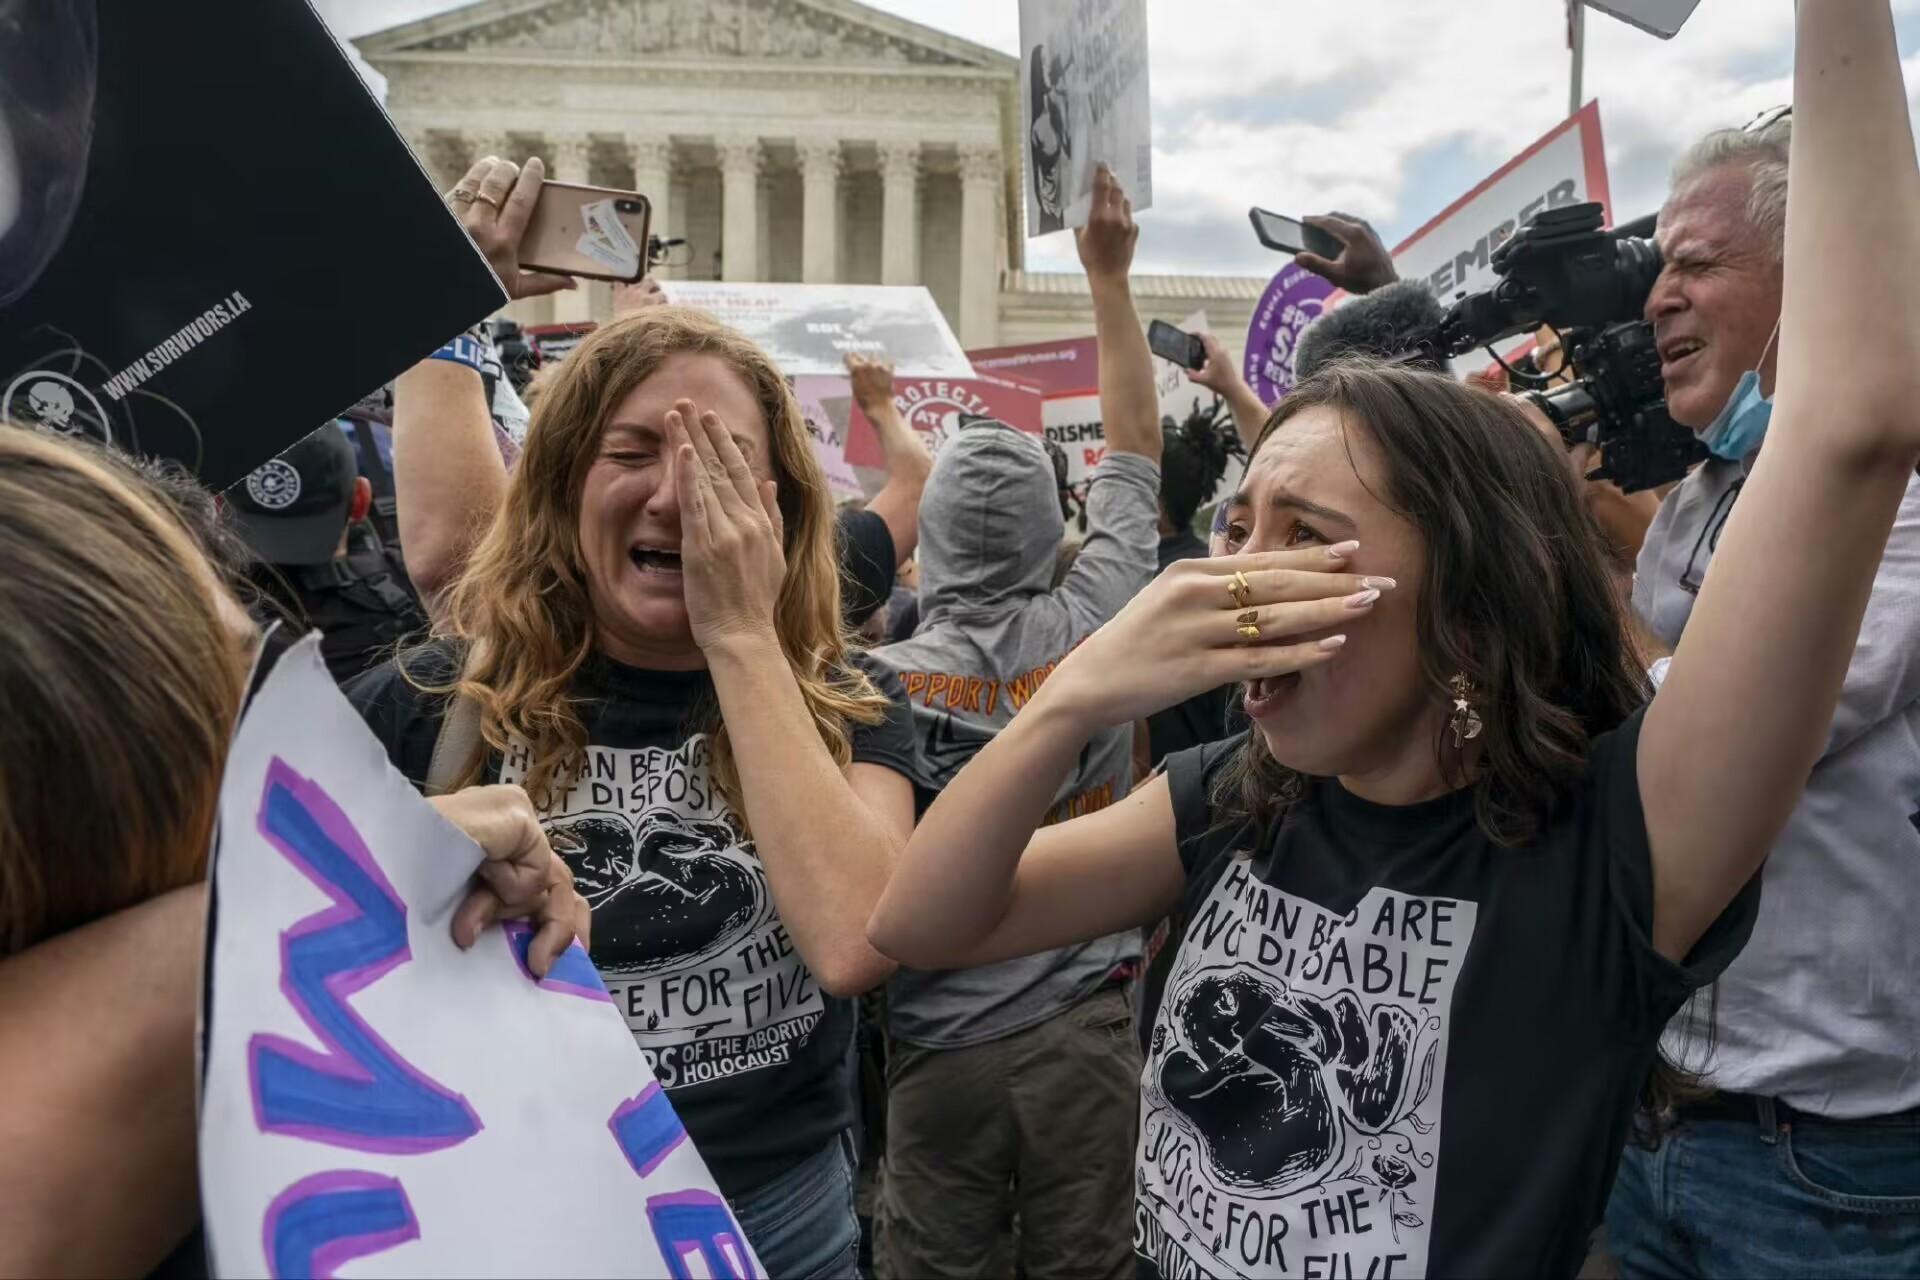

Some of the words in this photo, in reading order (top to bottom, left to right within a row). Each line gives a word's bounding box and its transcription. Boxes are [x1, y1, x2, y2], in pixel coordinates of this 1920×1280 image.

[101, 290, 252, 401] WWW.SURVIVORS.LA
[896, 381, 990, 416] ROTECT
[1045, 421, 1105, 443] DISME
[1371, 896, 1457, 947] ARE
[660, 967, 732, 1018] FOR
[736, 924, 795, 974] THE
[743, 964, 813, 1029] FIVE
[682, 1041, 704, 1063] OF
[707, 1036, 743, 1059] THE
[683, 1042, 790, 1084] HOLOCAUST
[1225, 1201, 1289, 1273] FOR
[1301, 1187, 1372, 1239] THE
